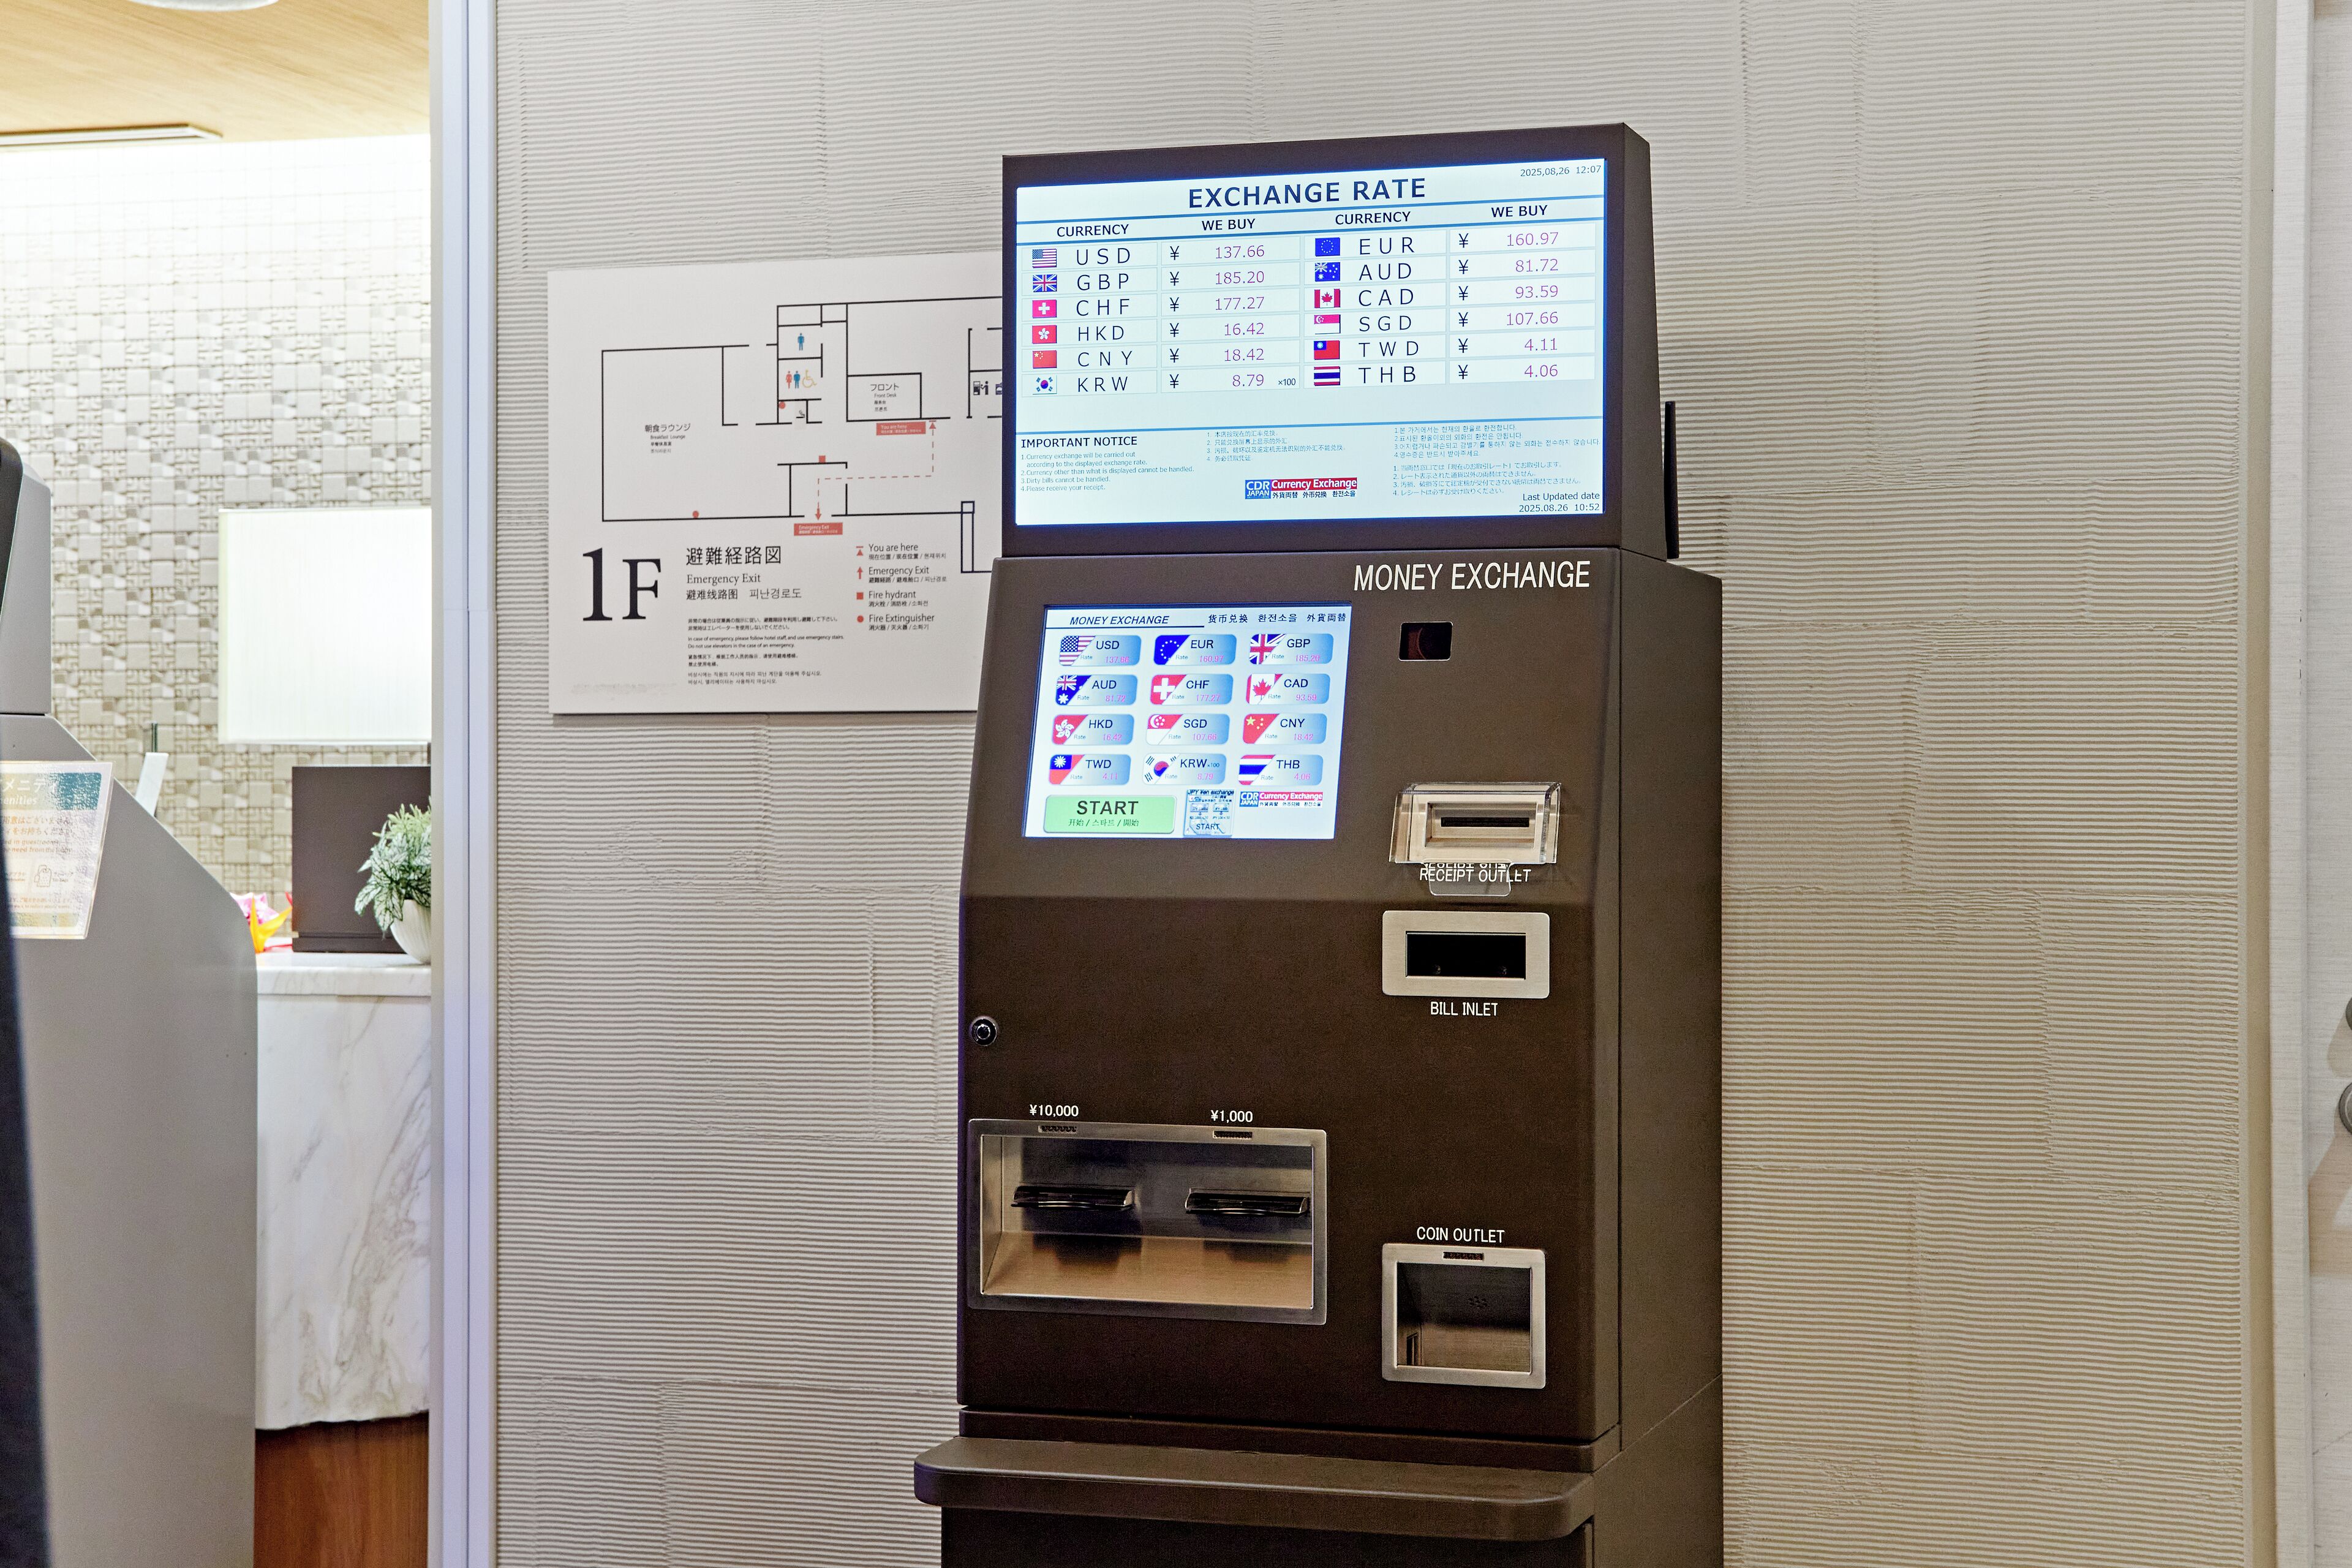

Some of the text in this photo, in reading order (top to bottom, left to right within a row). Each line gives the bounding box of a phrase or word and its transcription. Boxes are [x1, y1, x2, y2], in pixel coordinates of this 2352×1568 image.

[1189, 178, 1425, 208] EXCHANGE RATE
[1336, 205, 1547, 225] CURRENCY WE BUY
[1057, 219, 1255, 236] CURRENCY WE BUY
[1360, 232, 1558, 255] EUR ¥ 160.97
[1077, 244, 1265, 265] USD ¥ 137.66
[1359, 258, 1558, 281] AUD ¥ 81.72
[1077, 270, 1264, 290] GBP ¥ 185.20
[1359, 284, 1558, 306] CAD ¥ 93.59
[1077, 296, 1264, 316] CHF ¥ 177.27
[1360, 311, 1558, 331] SGD ¥ 107.66
[1079, 322, 1264, 341] HKD ¥ 16.42
[1359, 338, 1557, 357] TWD ¥ 4.11
[1078, 348, 1264, 366] CNY ¥ 18.42
[1359, 363, 1558, 383] THB ¥ 4.06
[870, 383, 900, 392] フロント
[1079, 377, 1128, 392] KRW
[1170, 374, 1178, 388] ¥
[1232, 372, 1264, 387] 8.79
[644, 423, 691, 432] 朝食ラウンジ
[1022, 437, 1137, 448] IMPORTANT NOTICE
[1246, 479, 1357, 491] CDR Currency Exchange
[1544, 492, 1578, 502] Updated
[687, 546, 780, 565] 避難経路図
[869, 567, 913, 576] Emergency
[1354, 561, 1590, 590] MONEY EXCHANGE
[583, 548, 661, 621] 1F
[687, 574, 760, 586] Emergency Exit
[687, 589, 801, 600] 避难线路图 피난경로도
[886, 614, 934, 622] Extinguisher
[1069, 616, 1108, 625] MONEY
[1307, 613, 1346, 622] 外貨両替
[1096, 641, 1120, 649] USD
[1191, 640, 1214, 649] EUR
[1287, 639, 1311, 647] GBP
[1092, 680, 1117, 689] AUD
[1186, 680, 1209, 689] CHF
[1284, 679, 1308, 688] CAD
[1089, 720, 1113, 728] HKD
[1184, 719, 1207, 728] SGD
[1280, 718, 1305, 728] CNY
[1181, 759, 1207, 767] KRW
[1276, 760, 1300, 769] THB
[1077, 801, 1138, 815] START
[1420, 868, 1531, 882] RECEIPT OUTLET
[1431, 1001, 1498, 1016] BILL INLET
[1030, 1104, 1079, 1117] ¥10,000
[1211, 1110, 1253, 1123] ¥1,000
[1417, 1227, 1505, 1243] COIN OUTLET
